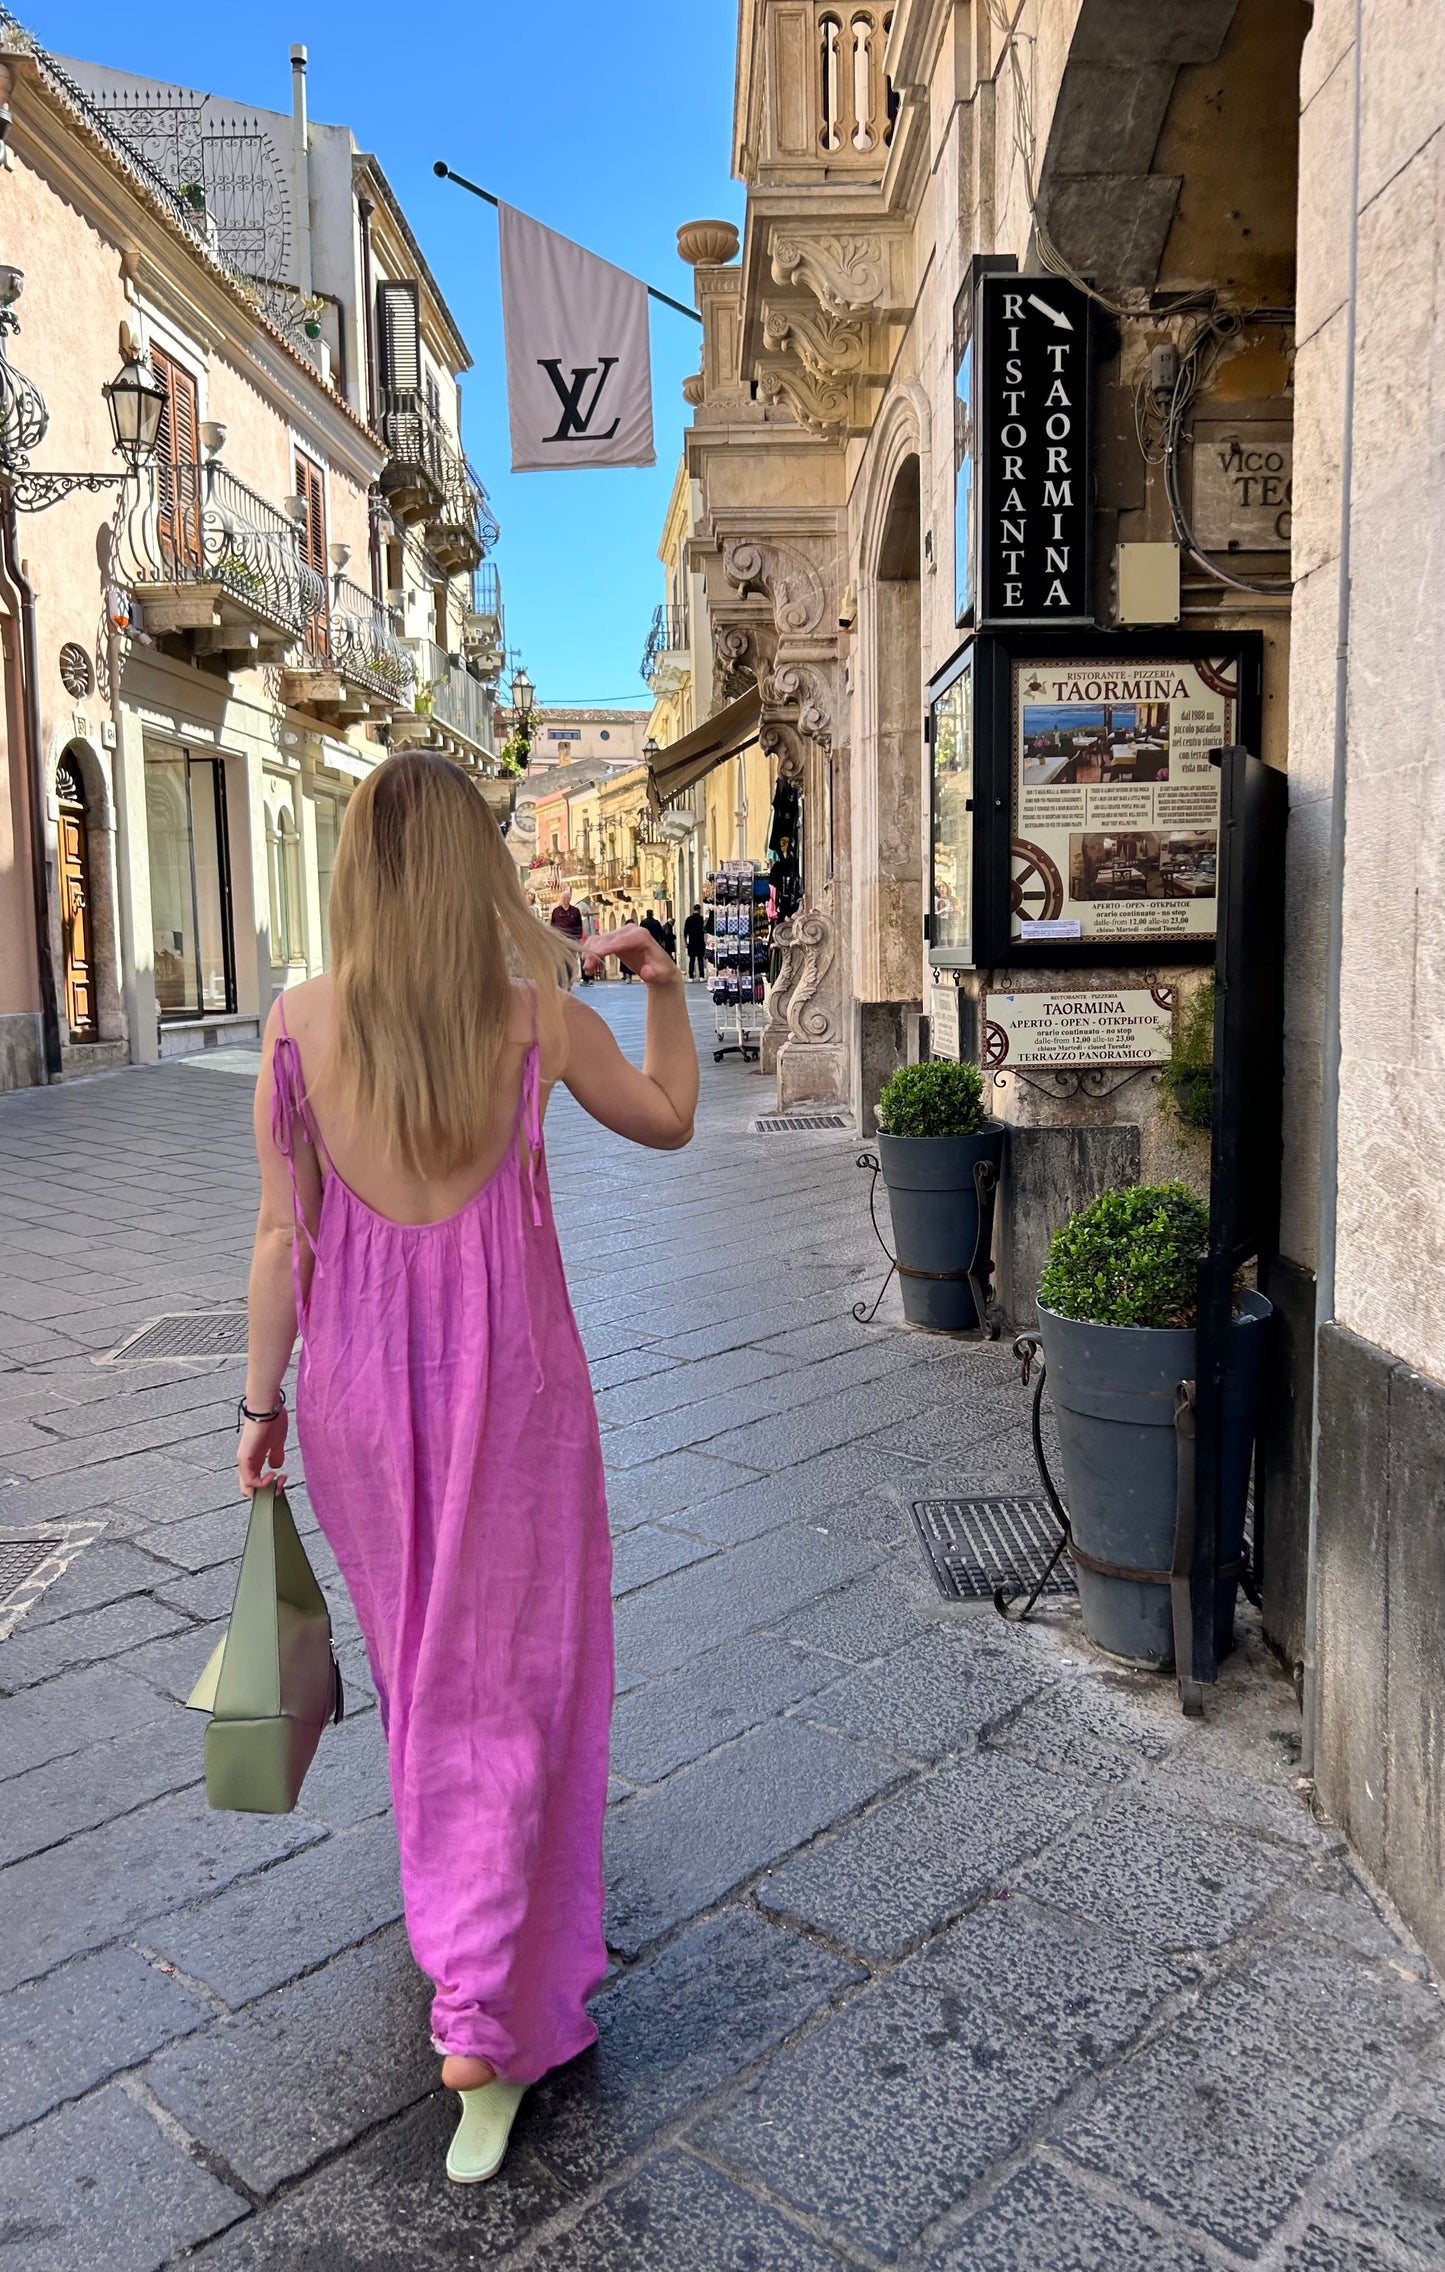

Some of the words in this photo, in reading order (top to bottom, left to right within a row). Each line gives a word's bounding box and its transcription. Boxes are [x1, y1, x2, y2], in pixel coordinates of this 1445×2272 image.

[1000, 293, 1028, 607] RISTORANTE
[1218, 451, 1284, 473] VICO
[1041, 344, 1075, 606] TAORMINA
[1067, 671, 1126, 681] RISTORANTE
[1133, 669, 1176, 679] PIZZERIA
[1052, 679, 1191, 702] TAORMINA
[1043, 1001, 1126, 1015] TAORMINA
[1010, 1019, 1052, 1028] APERTO
[1061, 1018, 1090, 1027] OPEN
[1061, 1028, 1100, 1036] continuato
[1018, 1052, 1076, 1062] TERRAZZO
[1079, 1050, 1152, 1060] PANORAMICO
